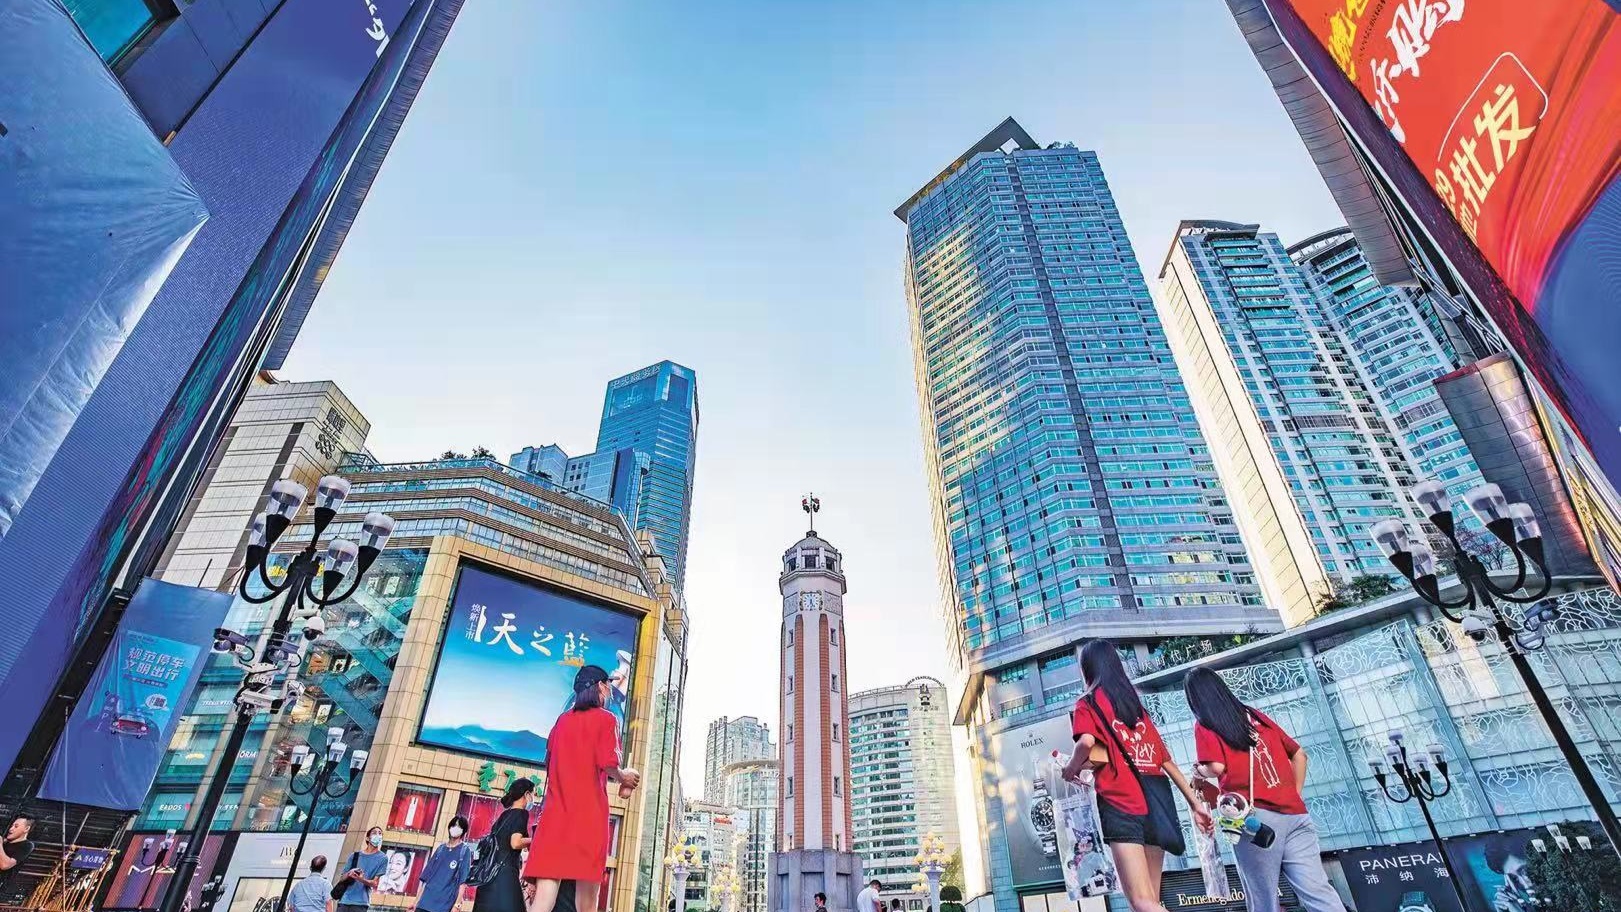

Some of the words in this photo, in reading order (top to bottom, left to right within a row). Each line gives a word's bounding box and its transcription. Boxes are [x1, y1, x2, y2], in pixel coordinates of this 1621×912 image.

[1449, 83, 1536, 217] 批发
[128, 647, 185, 668] 规范停车
[122, 660, 179, 680] 文明出行
[1020, 737, 1044, 748] ROLEX
[1365, 867, 1450, 885] 沛纳海
